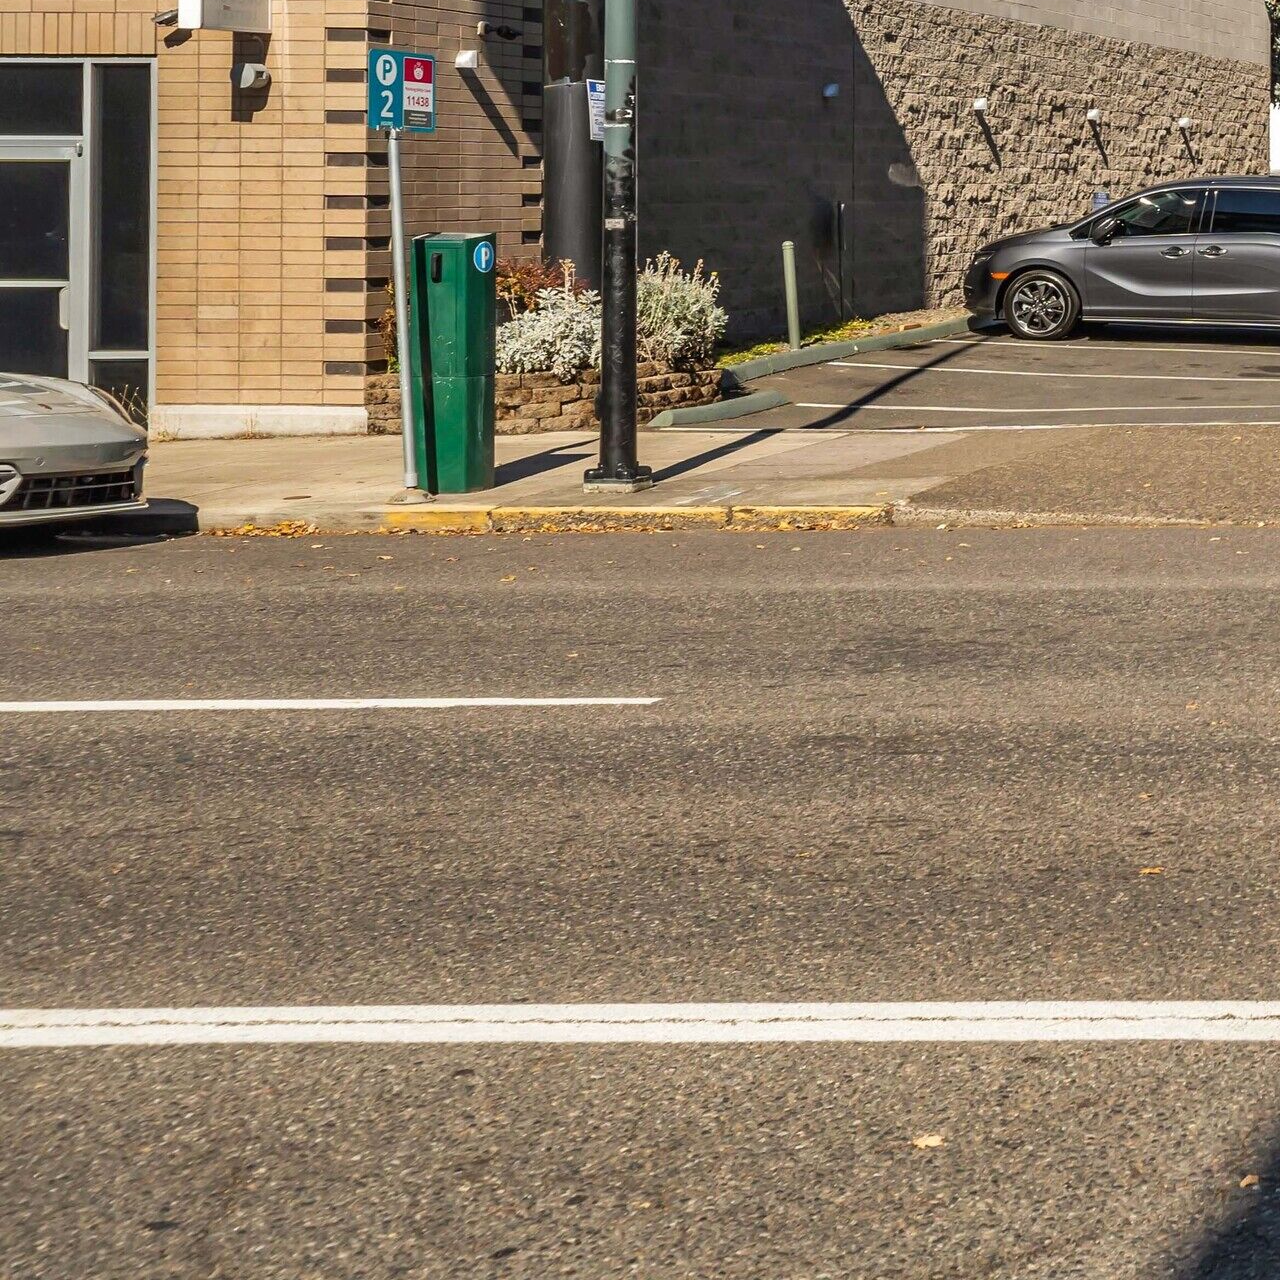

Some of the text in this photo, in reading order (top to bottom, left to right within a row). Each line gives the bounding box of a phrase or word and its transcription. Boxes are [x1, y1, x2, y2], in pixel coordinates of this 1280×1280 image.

[382, 59, 393, 81] P
[380, 89, 394, 118] 2
[407, 96, 430, 108] 11438
[481, 247, 490, 269] P
